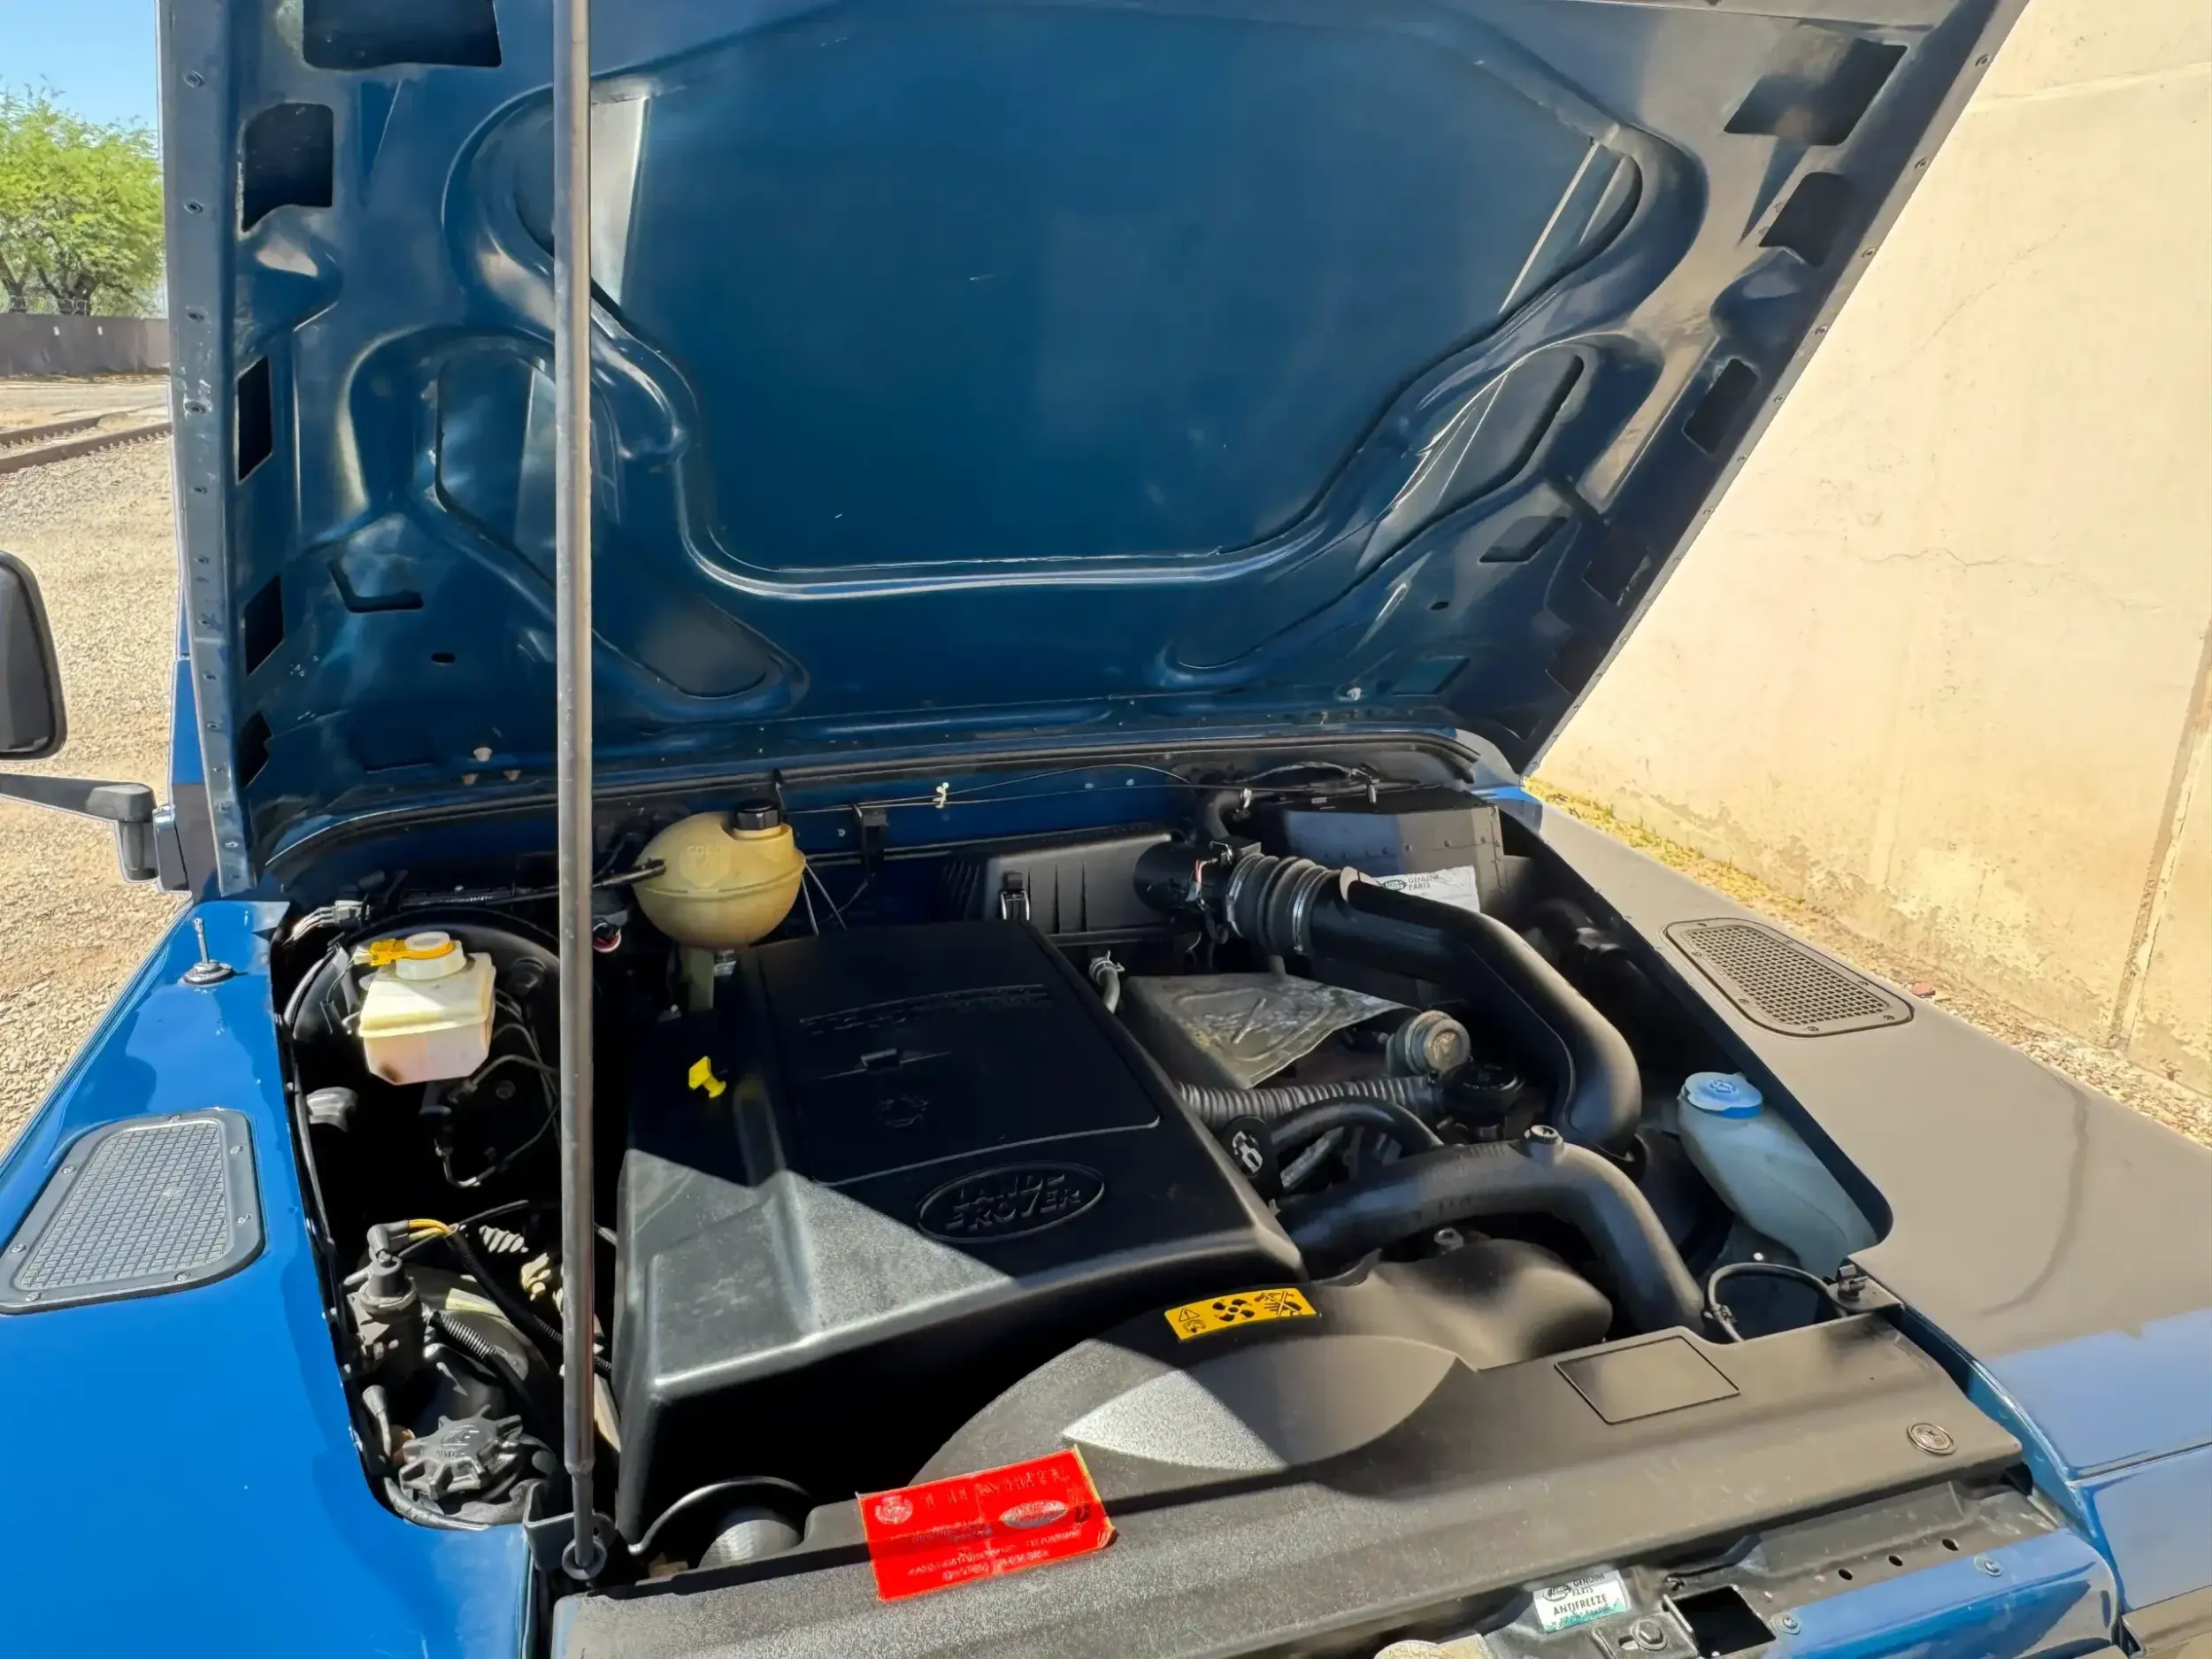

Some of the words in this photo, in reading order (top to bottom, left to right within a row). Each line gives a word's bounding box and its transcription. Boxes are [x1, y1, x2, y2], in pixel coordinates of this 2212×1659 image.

[966, 1189, 1082, 1232] ROVER
[1571, 1586, 1594, 1597] PARTS
[1553, 1594, 1608, 1616] ANTIFREEZE
